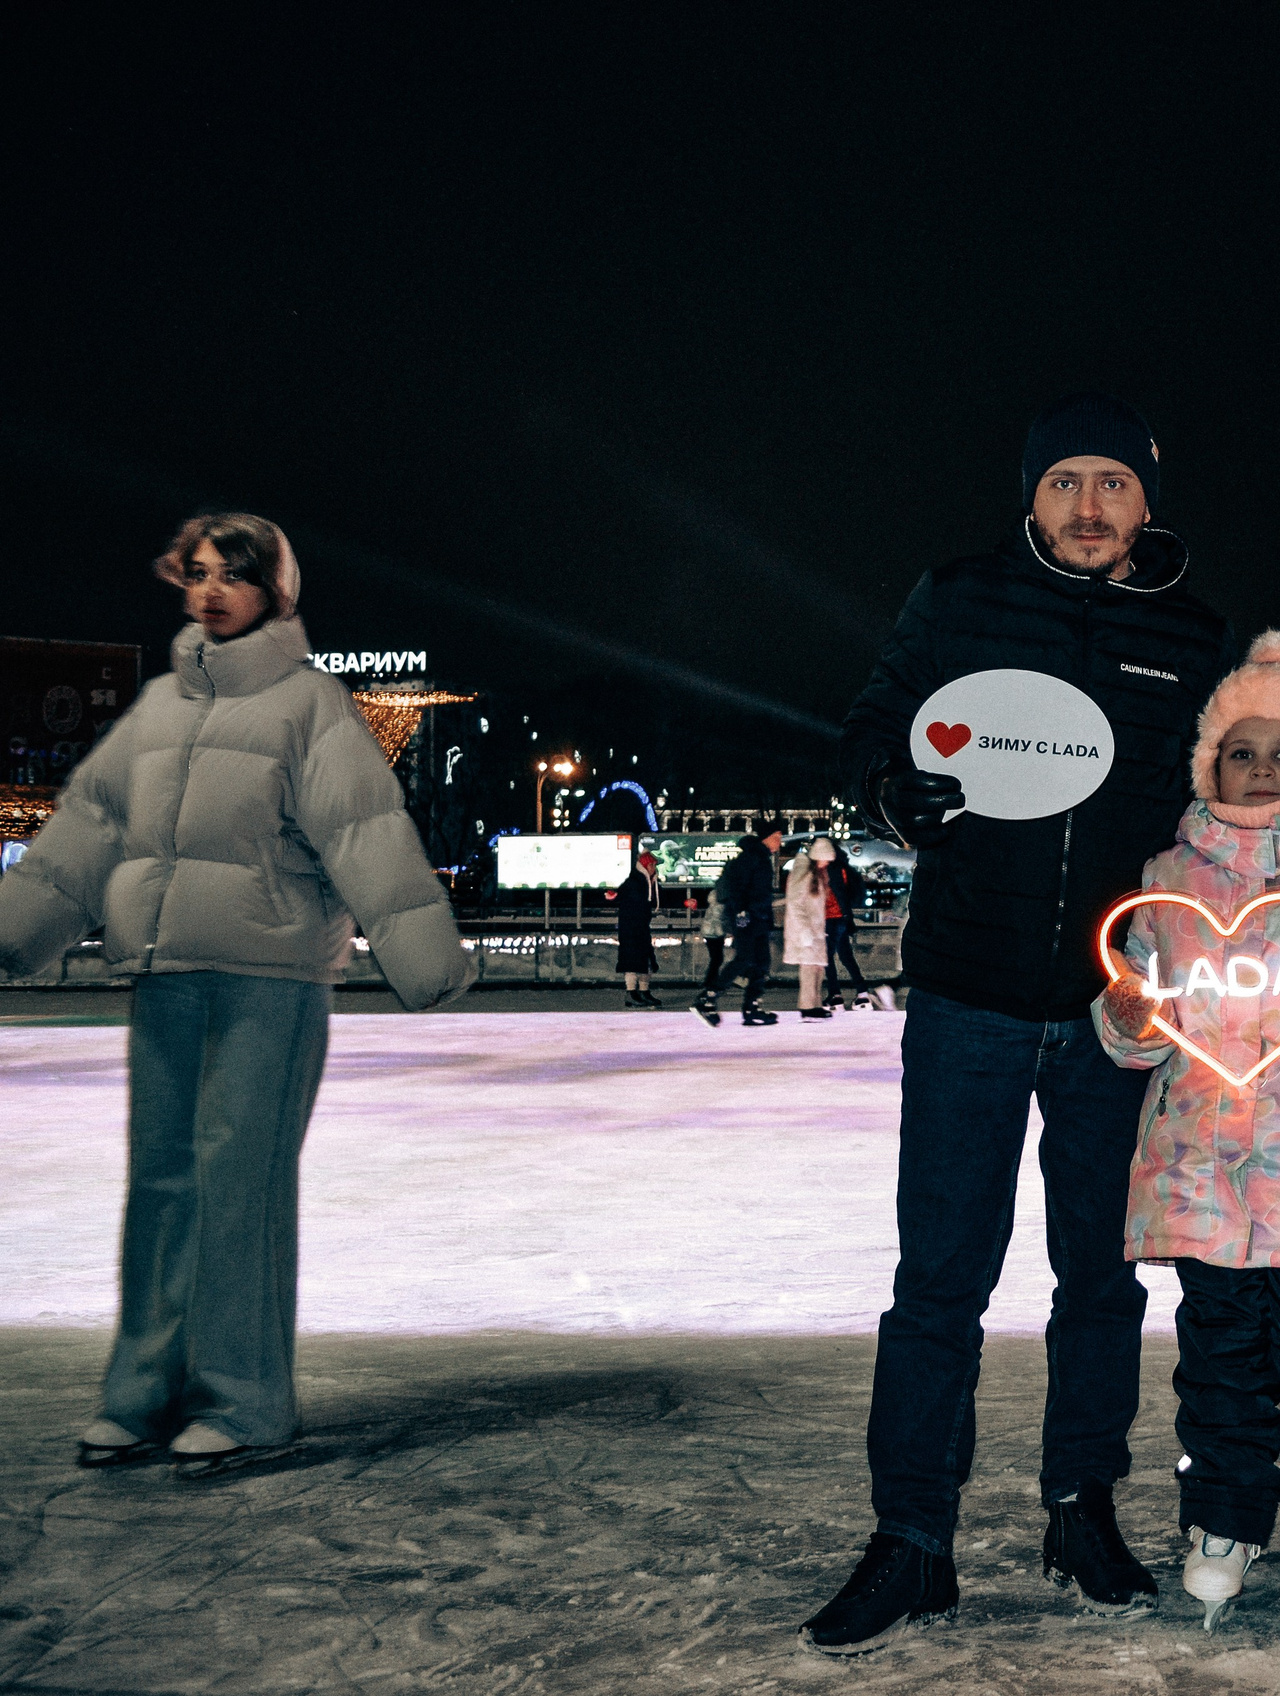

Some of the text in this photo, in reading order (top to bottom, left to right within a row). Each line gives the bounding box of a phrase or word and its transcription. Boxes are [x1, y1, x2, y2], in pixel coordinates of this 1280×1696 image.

[307, 651, 427, 674] КВАРИУМ
[1120, 663, 1143, 675] CALVIN
[1143, 667, 1161, 678] KLEIN
[978, 735, 1032, 752] ЗИМУ
[1052, 742, 1100, 759] LADA
